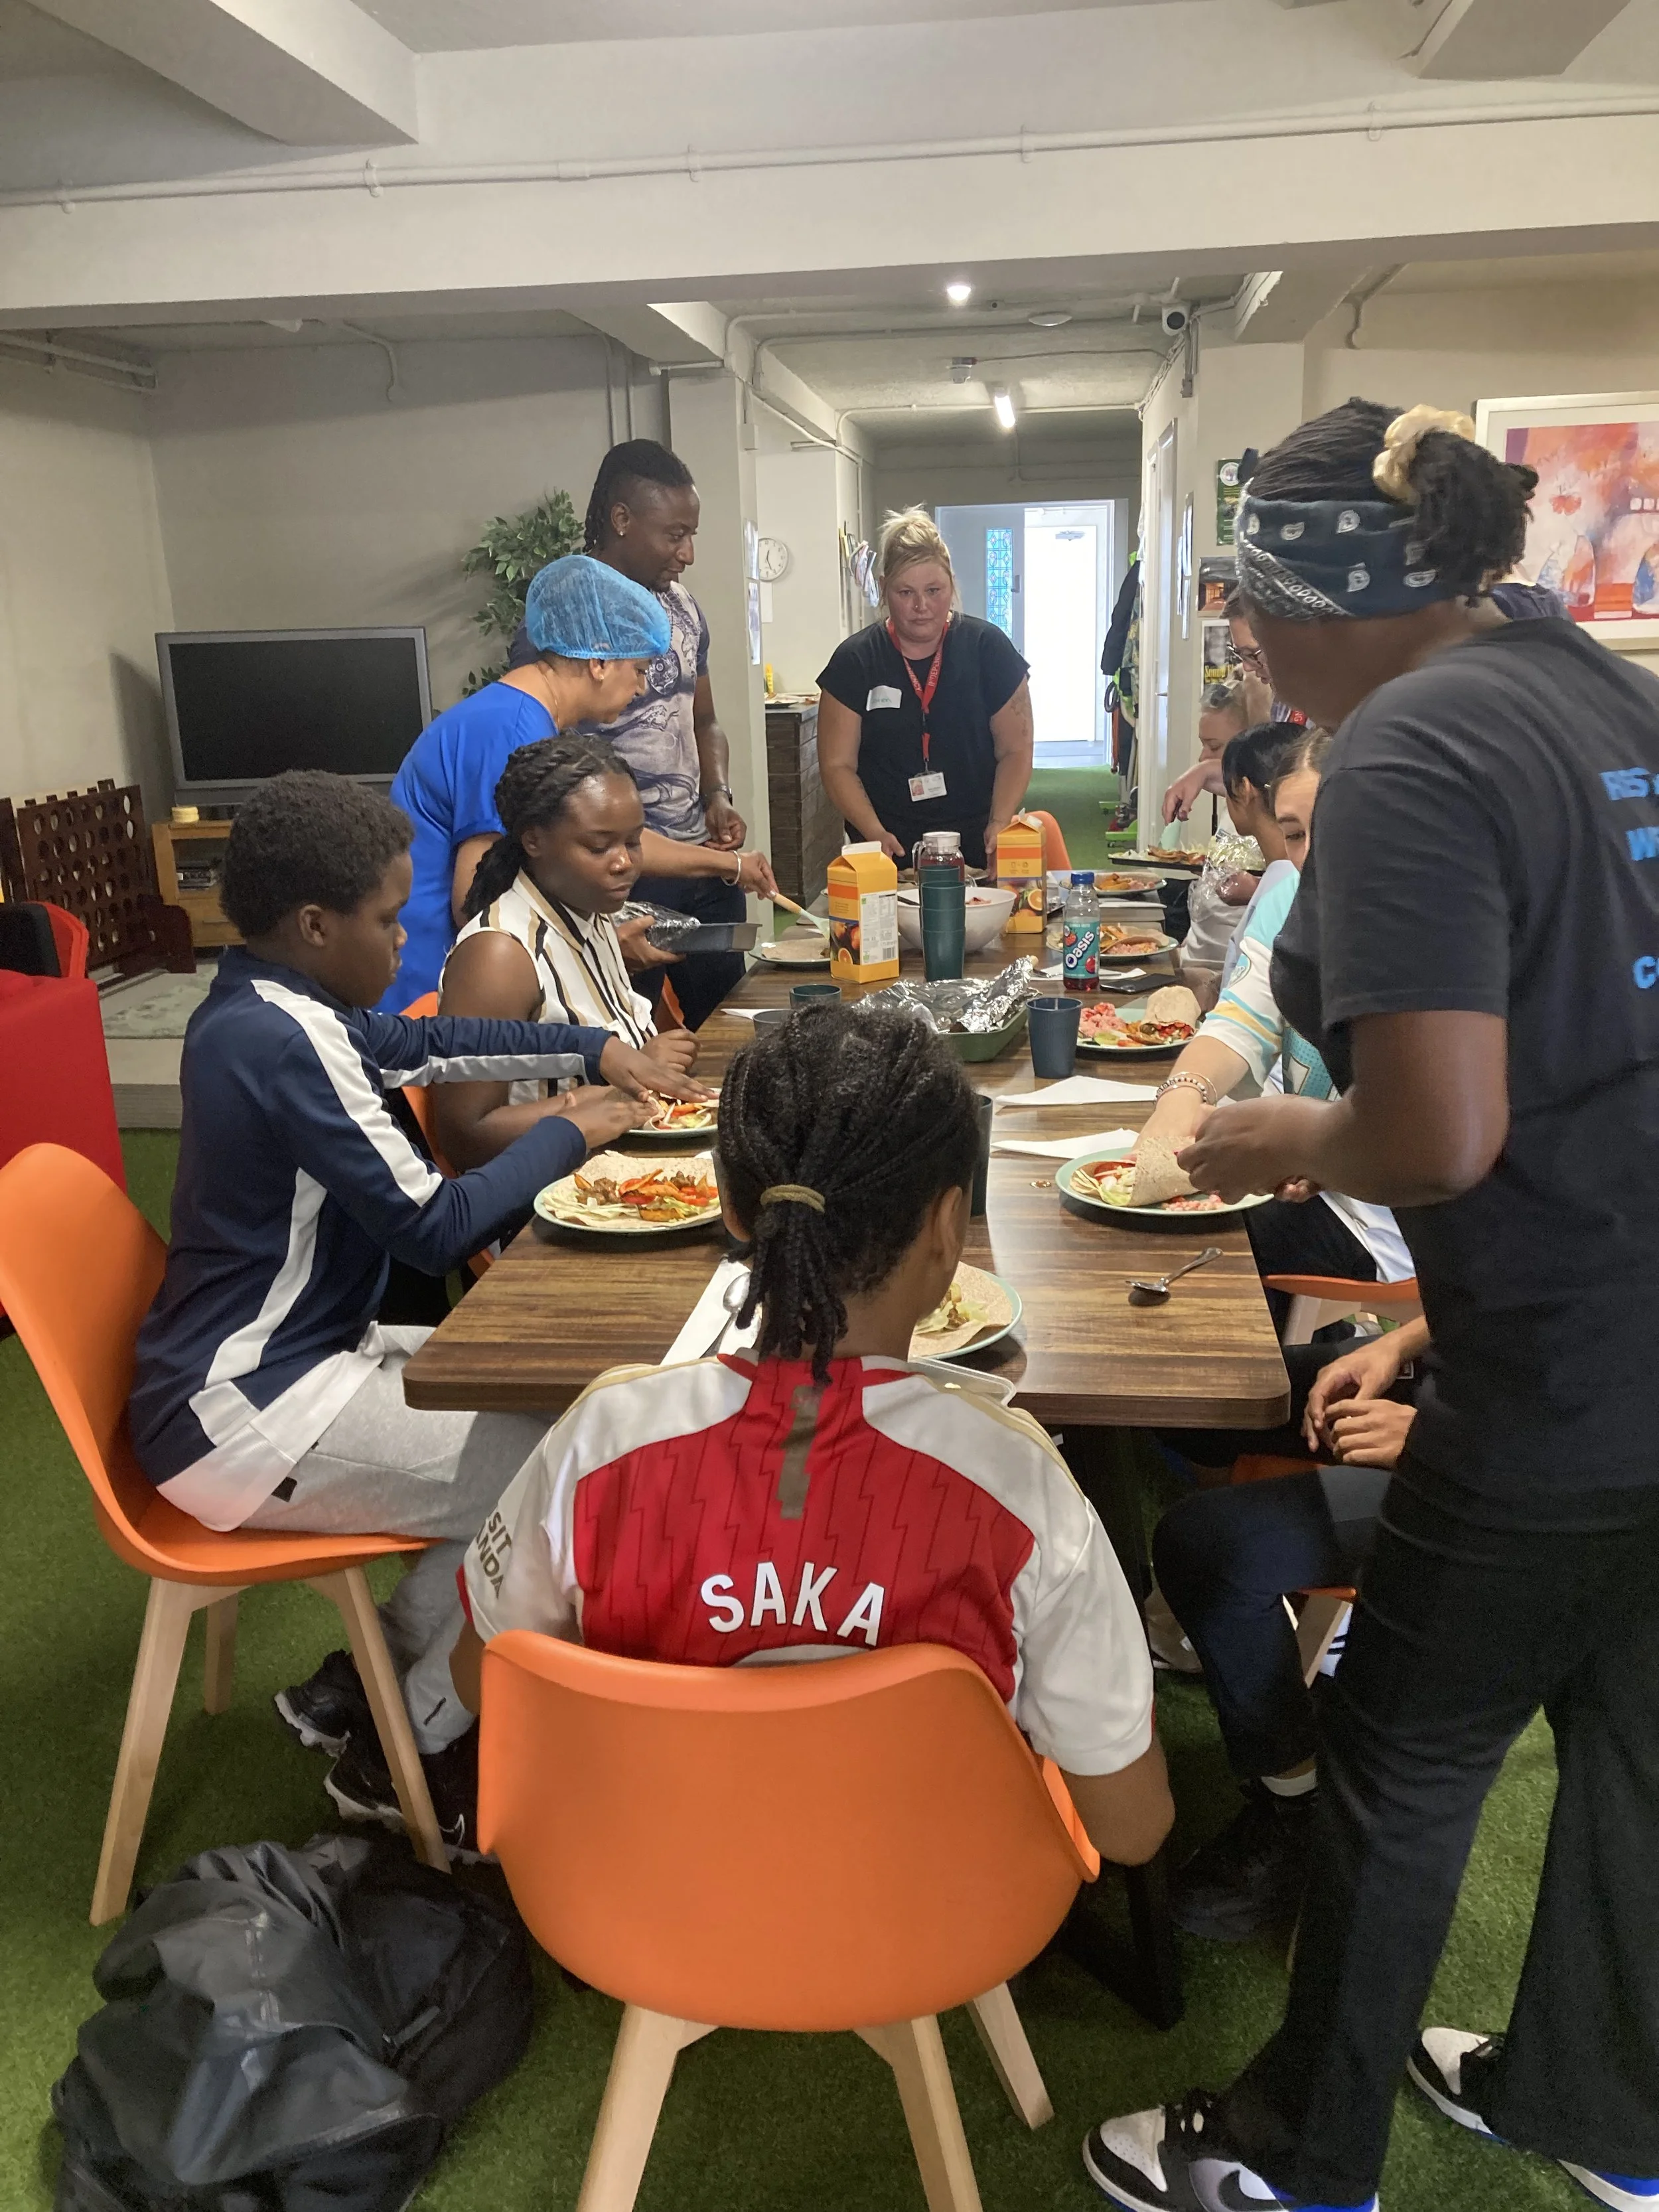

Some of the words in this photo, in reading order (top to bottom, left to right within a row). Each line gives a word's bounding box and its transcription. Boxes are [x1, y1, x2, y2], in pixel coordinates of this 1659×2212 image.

[1293, 710, 1303, 722] NG
[1065, 930, 1095, 968] Oasis
[488, 1511, 512, 1554] SIT
[700, 1562, 885, 1647] SAKA
